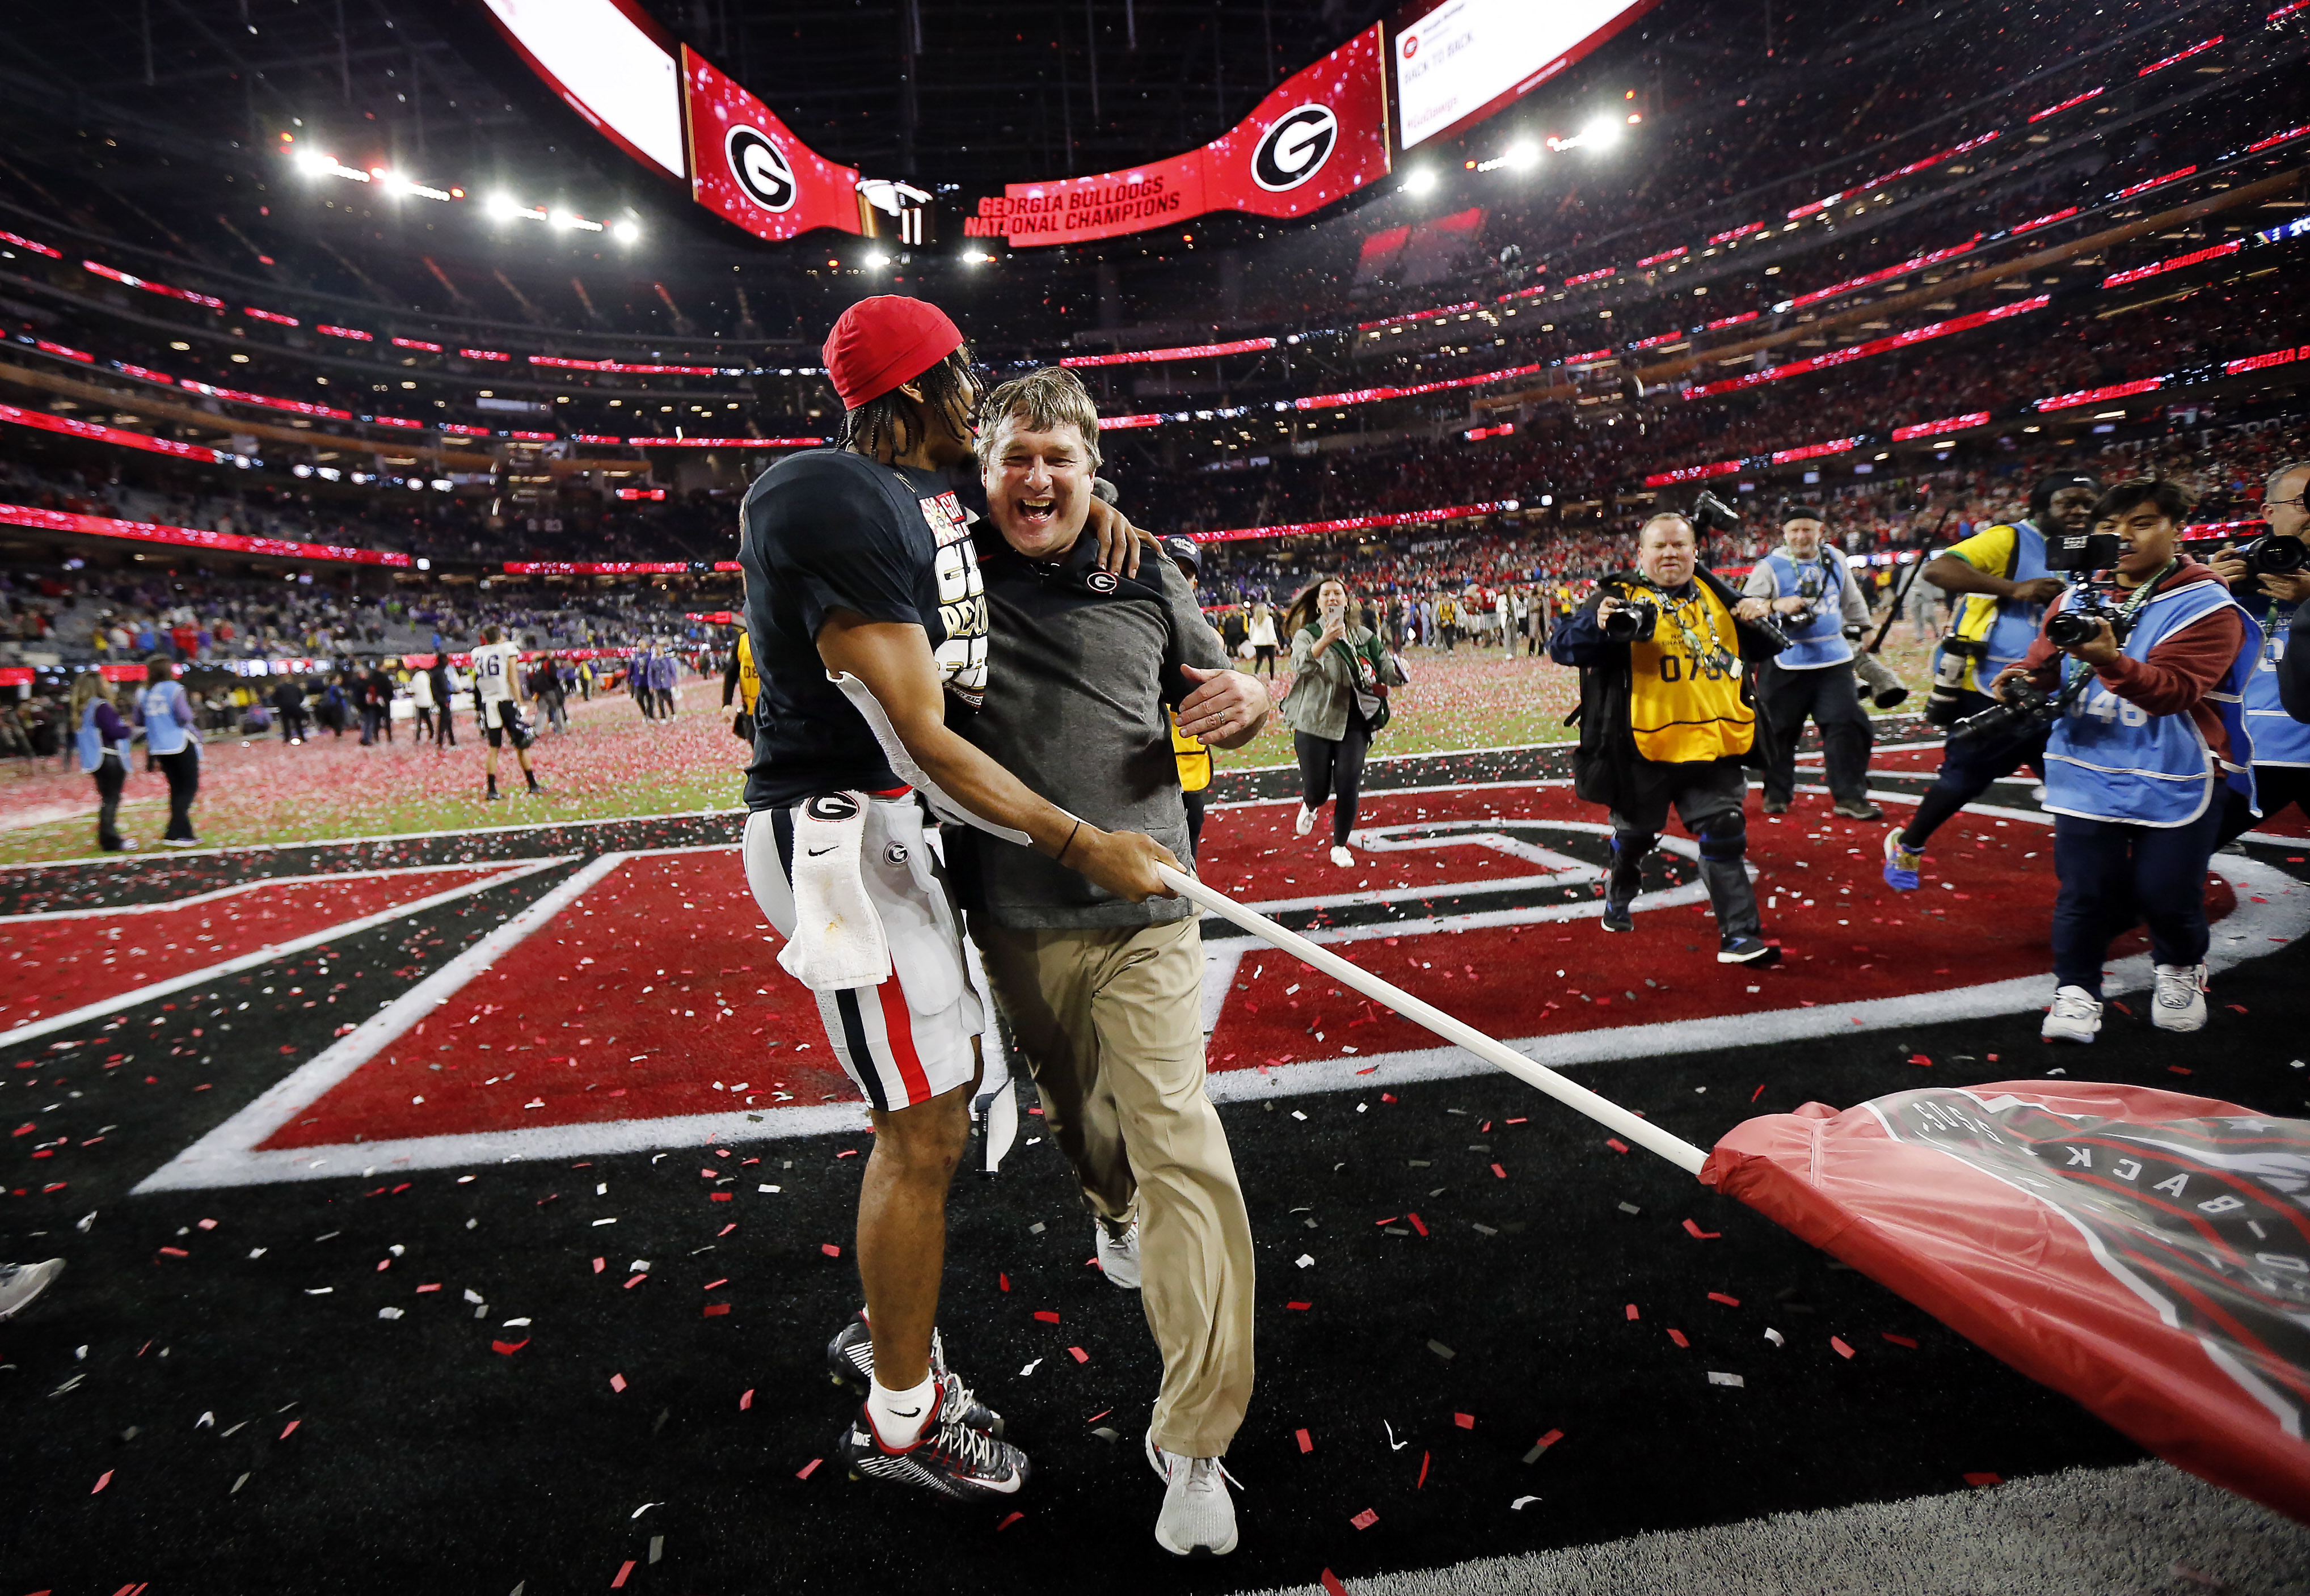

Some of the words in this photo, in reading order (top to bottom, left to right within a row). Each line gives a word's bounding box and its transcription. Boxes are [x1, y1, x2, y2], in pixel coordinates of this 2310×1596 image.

[728, 128, 796, 210] G
[1254, 107, 1335, 188] G
[964, 215, 1059, 237] NATIONAL
[1065, 192, 1180, 230] CHAMPIONS
[977, 194, 1063, 217] GEORGIA
[1069, 175, 1164, 210] BULLDOGS
[851, 1431, 871, 1447] NIKE
